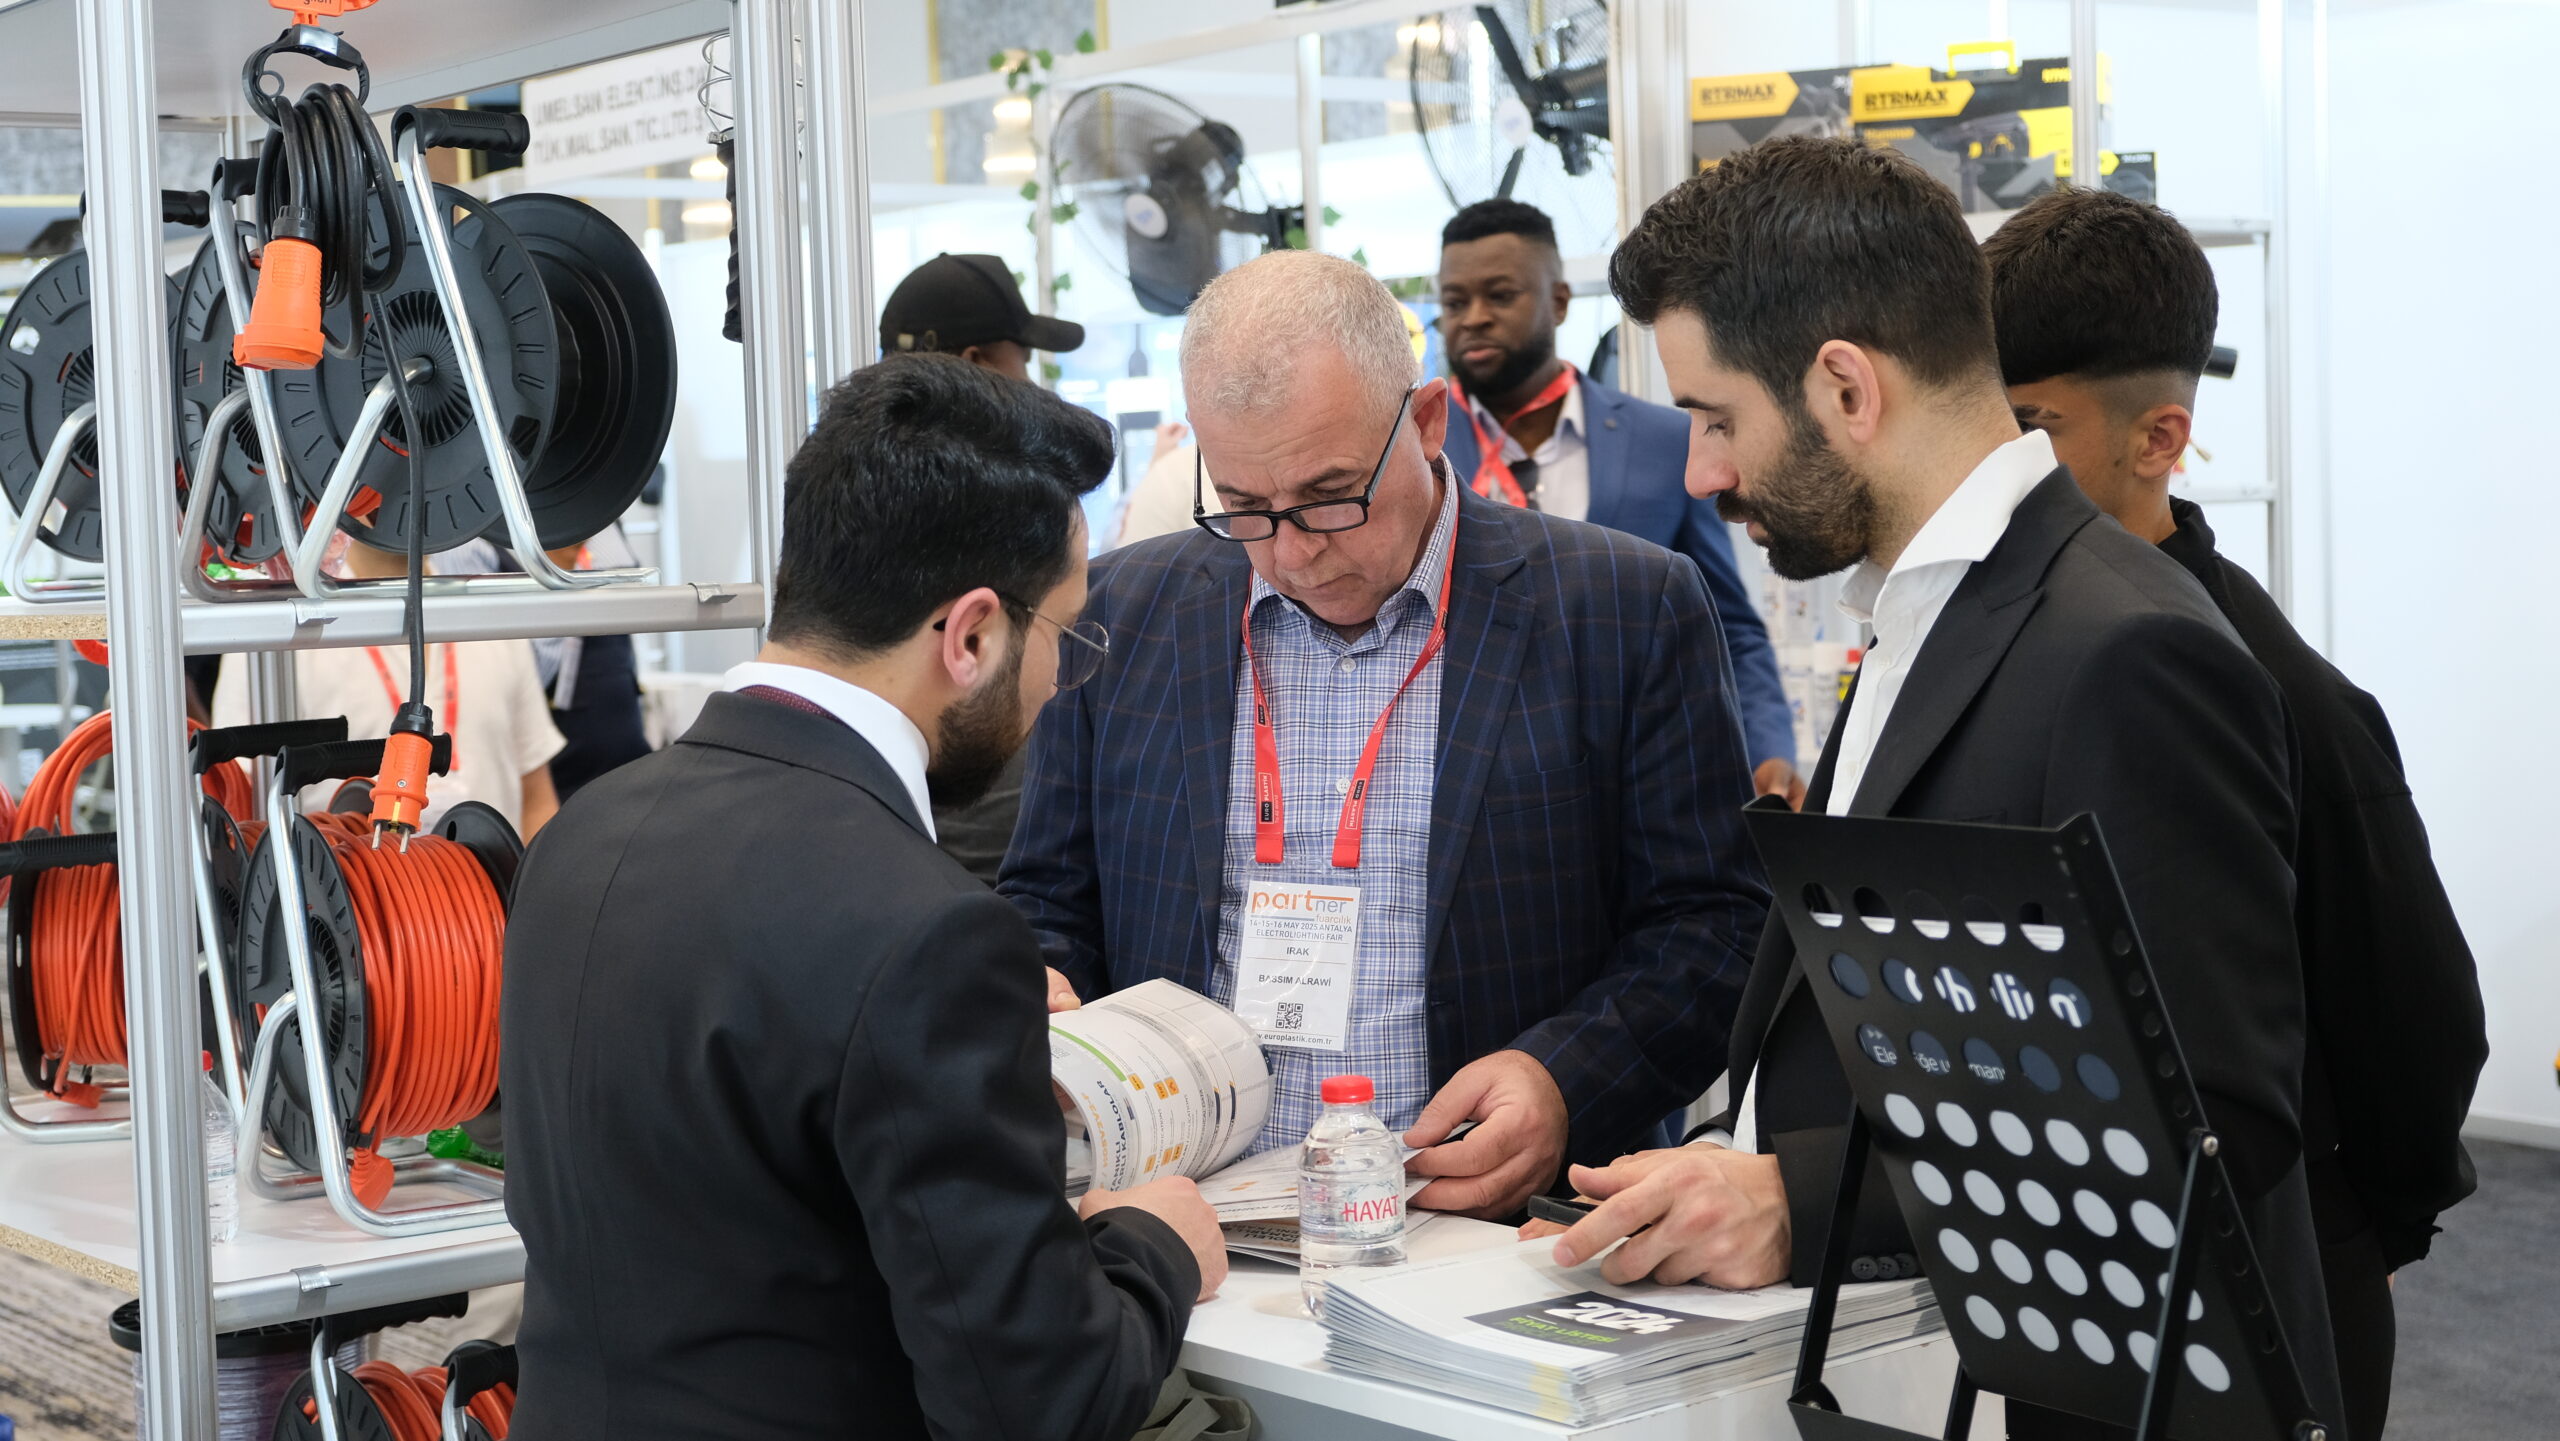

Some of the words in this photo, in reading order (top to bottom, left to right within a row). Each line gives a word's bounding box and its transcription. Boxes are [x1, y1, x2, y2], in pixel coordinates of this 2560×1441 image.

[1701, 83, 1776, 104] RTRMAX
[1864, 88, 1949, 109] RTRMAX
[1251, 890, 1353, 914] partner
[1256, 928, 1325, 941] ELECTROLIGHTING
[1326, 933, 1343, 942] FAIR
[1283, 921, 1300, 930] MAY
[1301, 922, 1318, 931] 2025
[1319, 924, 1353, 933] ANTALYA
[1286, 946, 1310, 956] IRAK
[1096, 1080, 1127, 1151] KABLOLAR
[1342, 1195, 1399, 1223] HAYAT
[1544, 1301, 1685, 1335] 2024
